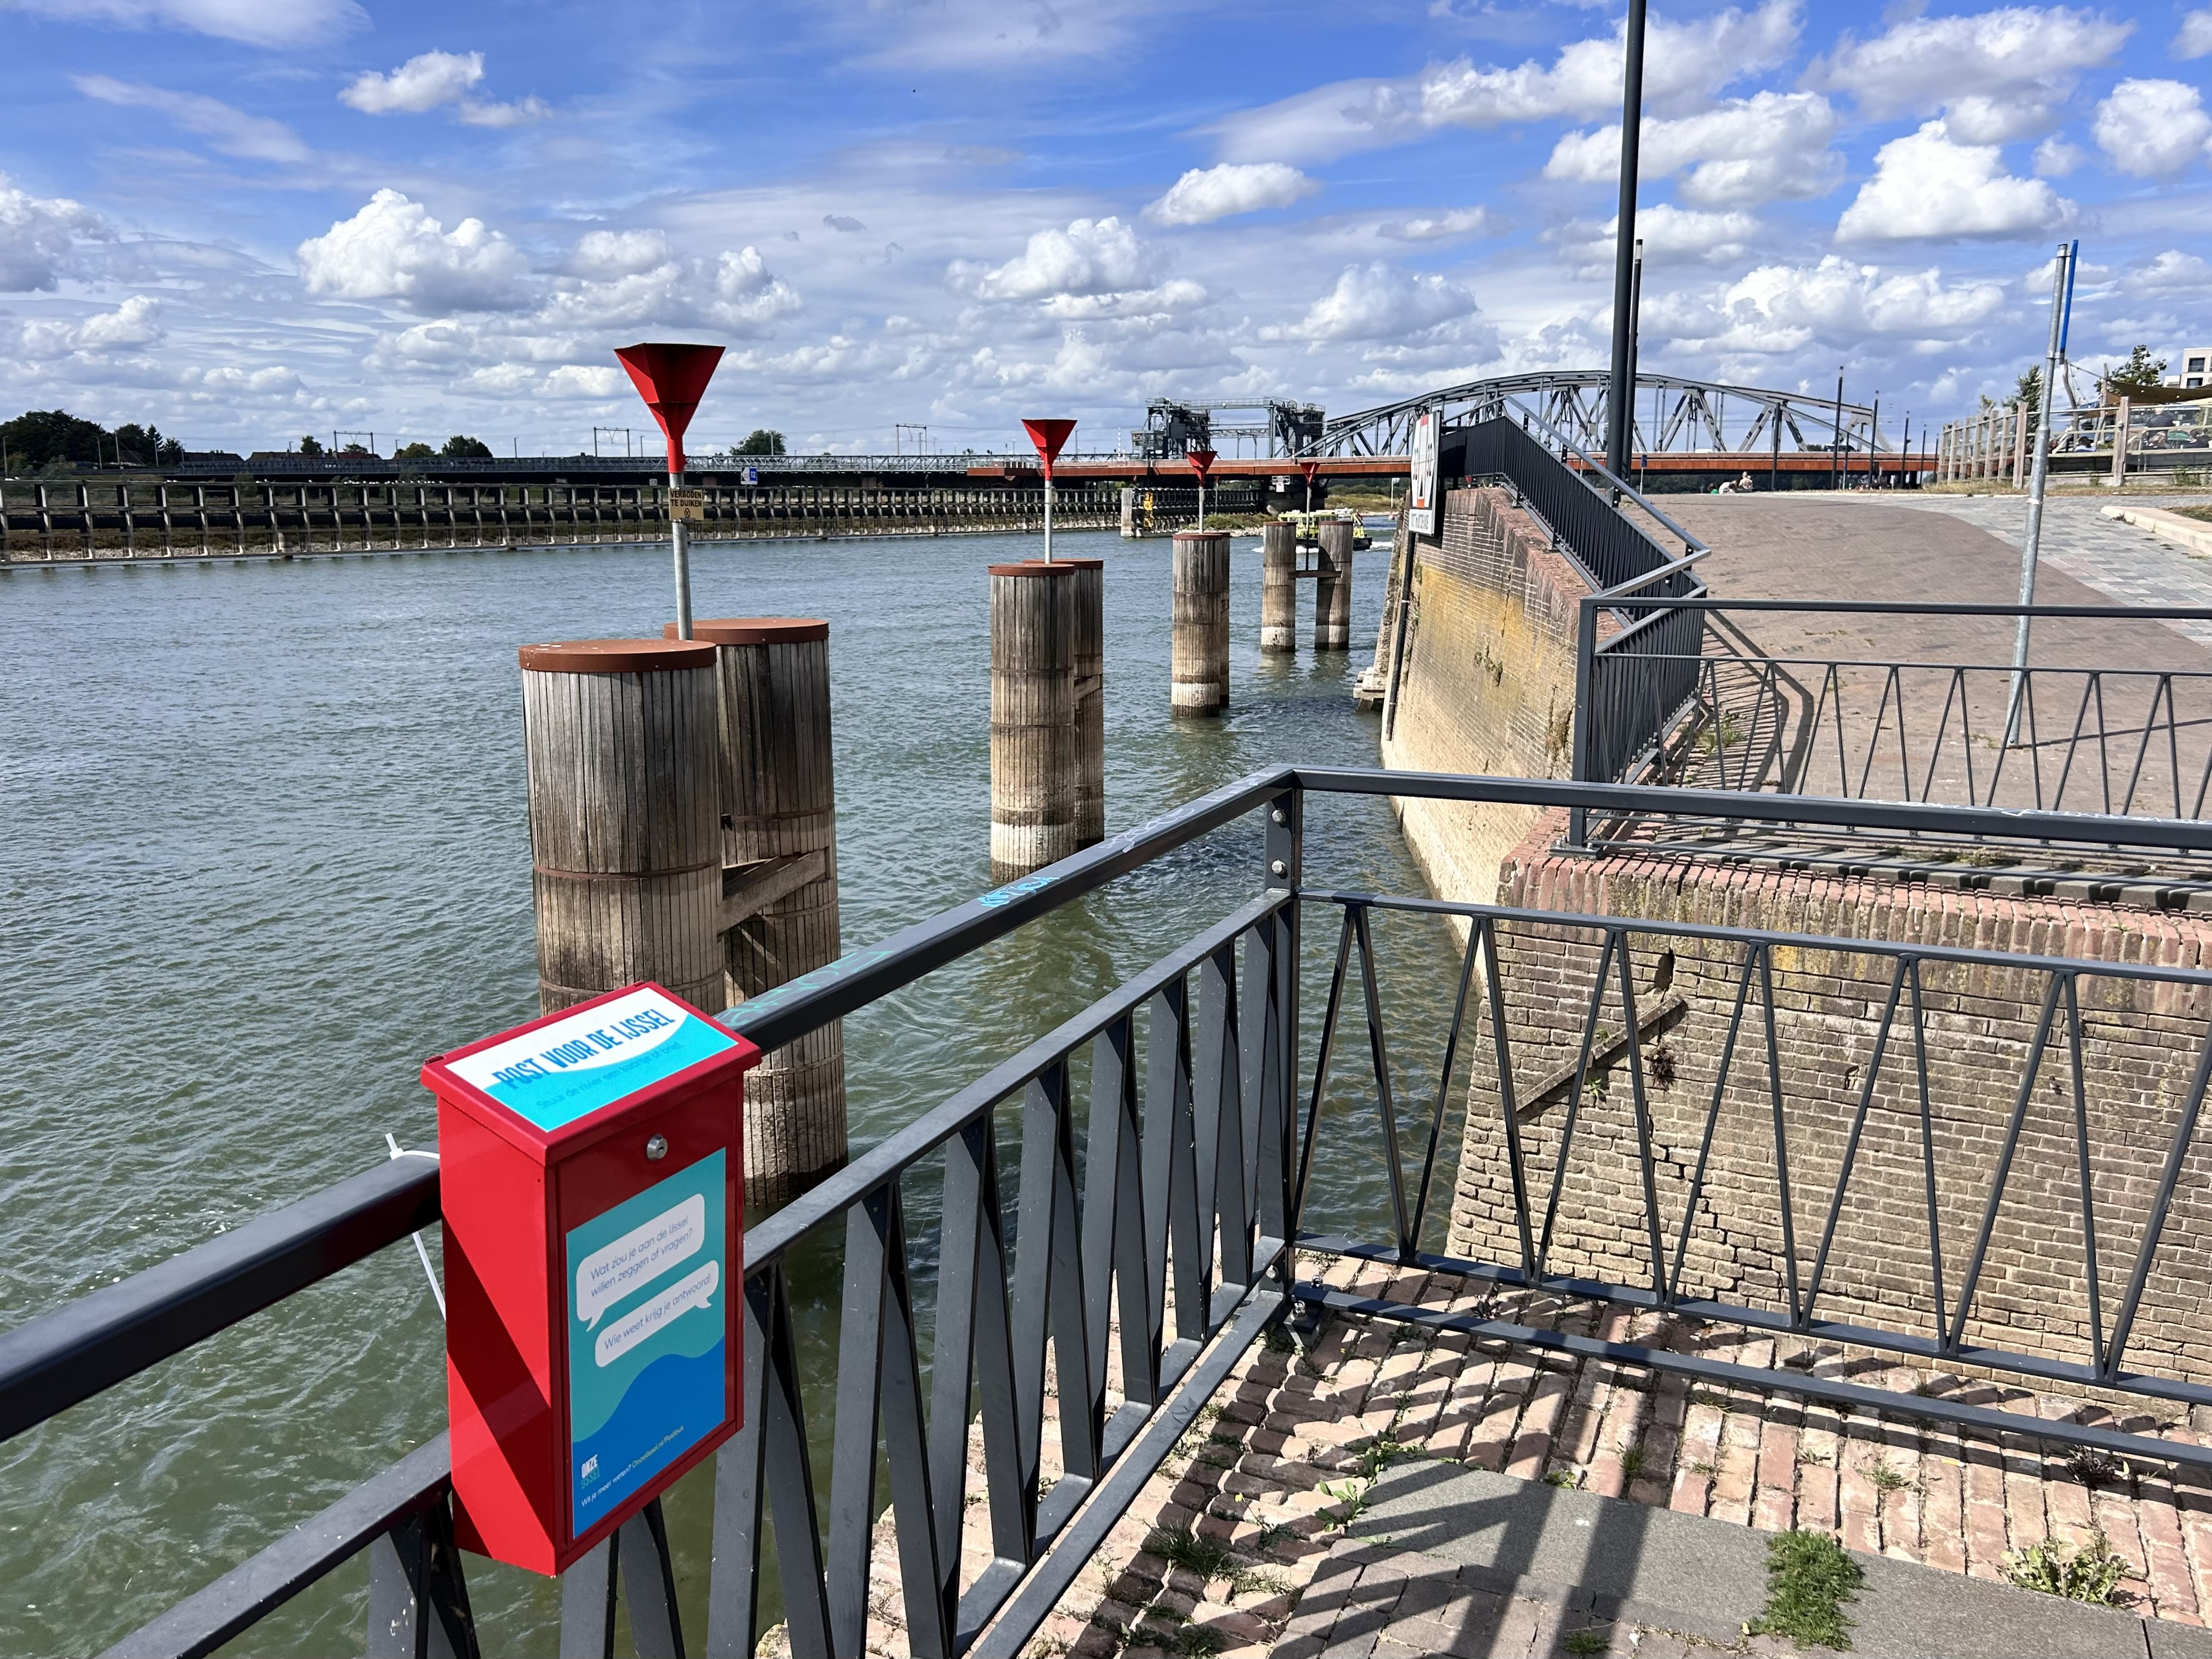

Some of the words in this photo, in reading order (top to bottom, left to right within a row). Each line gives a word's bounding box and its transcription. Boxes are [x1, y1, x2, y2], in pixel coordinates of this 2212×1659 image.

[491, 1058, 552, 1089] POST
[539, 1039, 599, 1068] VOOR
[585, 1029, 623, 1050] DE
[610, 1009, 676, 1039] IJSSEL
[603, 1069, 620, 1080] een
[591, 1264, 609, 1280] Wat
[611, 1256, 627, 1269] zou
[629, 1248, 636, 1262] je
[638, 1237, 654, 1252] aan
[657, 1230, 667, 1241] de
[669, 1216, 688, 1234] IJssel
[591, 1276, 616, 1297] willen
[618, 1257, 649, 1282] zeggen
[651, 1248, 659, 1261] of
[661, 1228, 693, 1254] vragen?
[604, 1334, 621, 1349] Wie
[623, 1319, 643, 1337] weet
[645, 1307, 663, 1324] krijg
[663, 1302, 671, 1314] je
[673, 1273, 711, 1305] antwoord!
[581, 1454, 598, 1479] ONZE
[581, 1496, 591, 1507] Wil
[591, 1492, 597, 1502] je
[598, 1481, 612, 1495] meer
[613, 1464, 631, 1483] weten?
